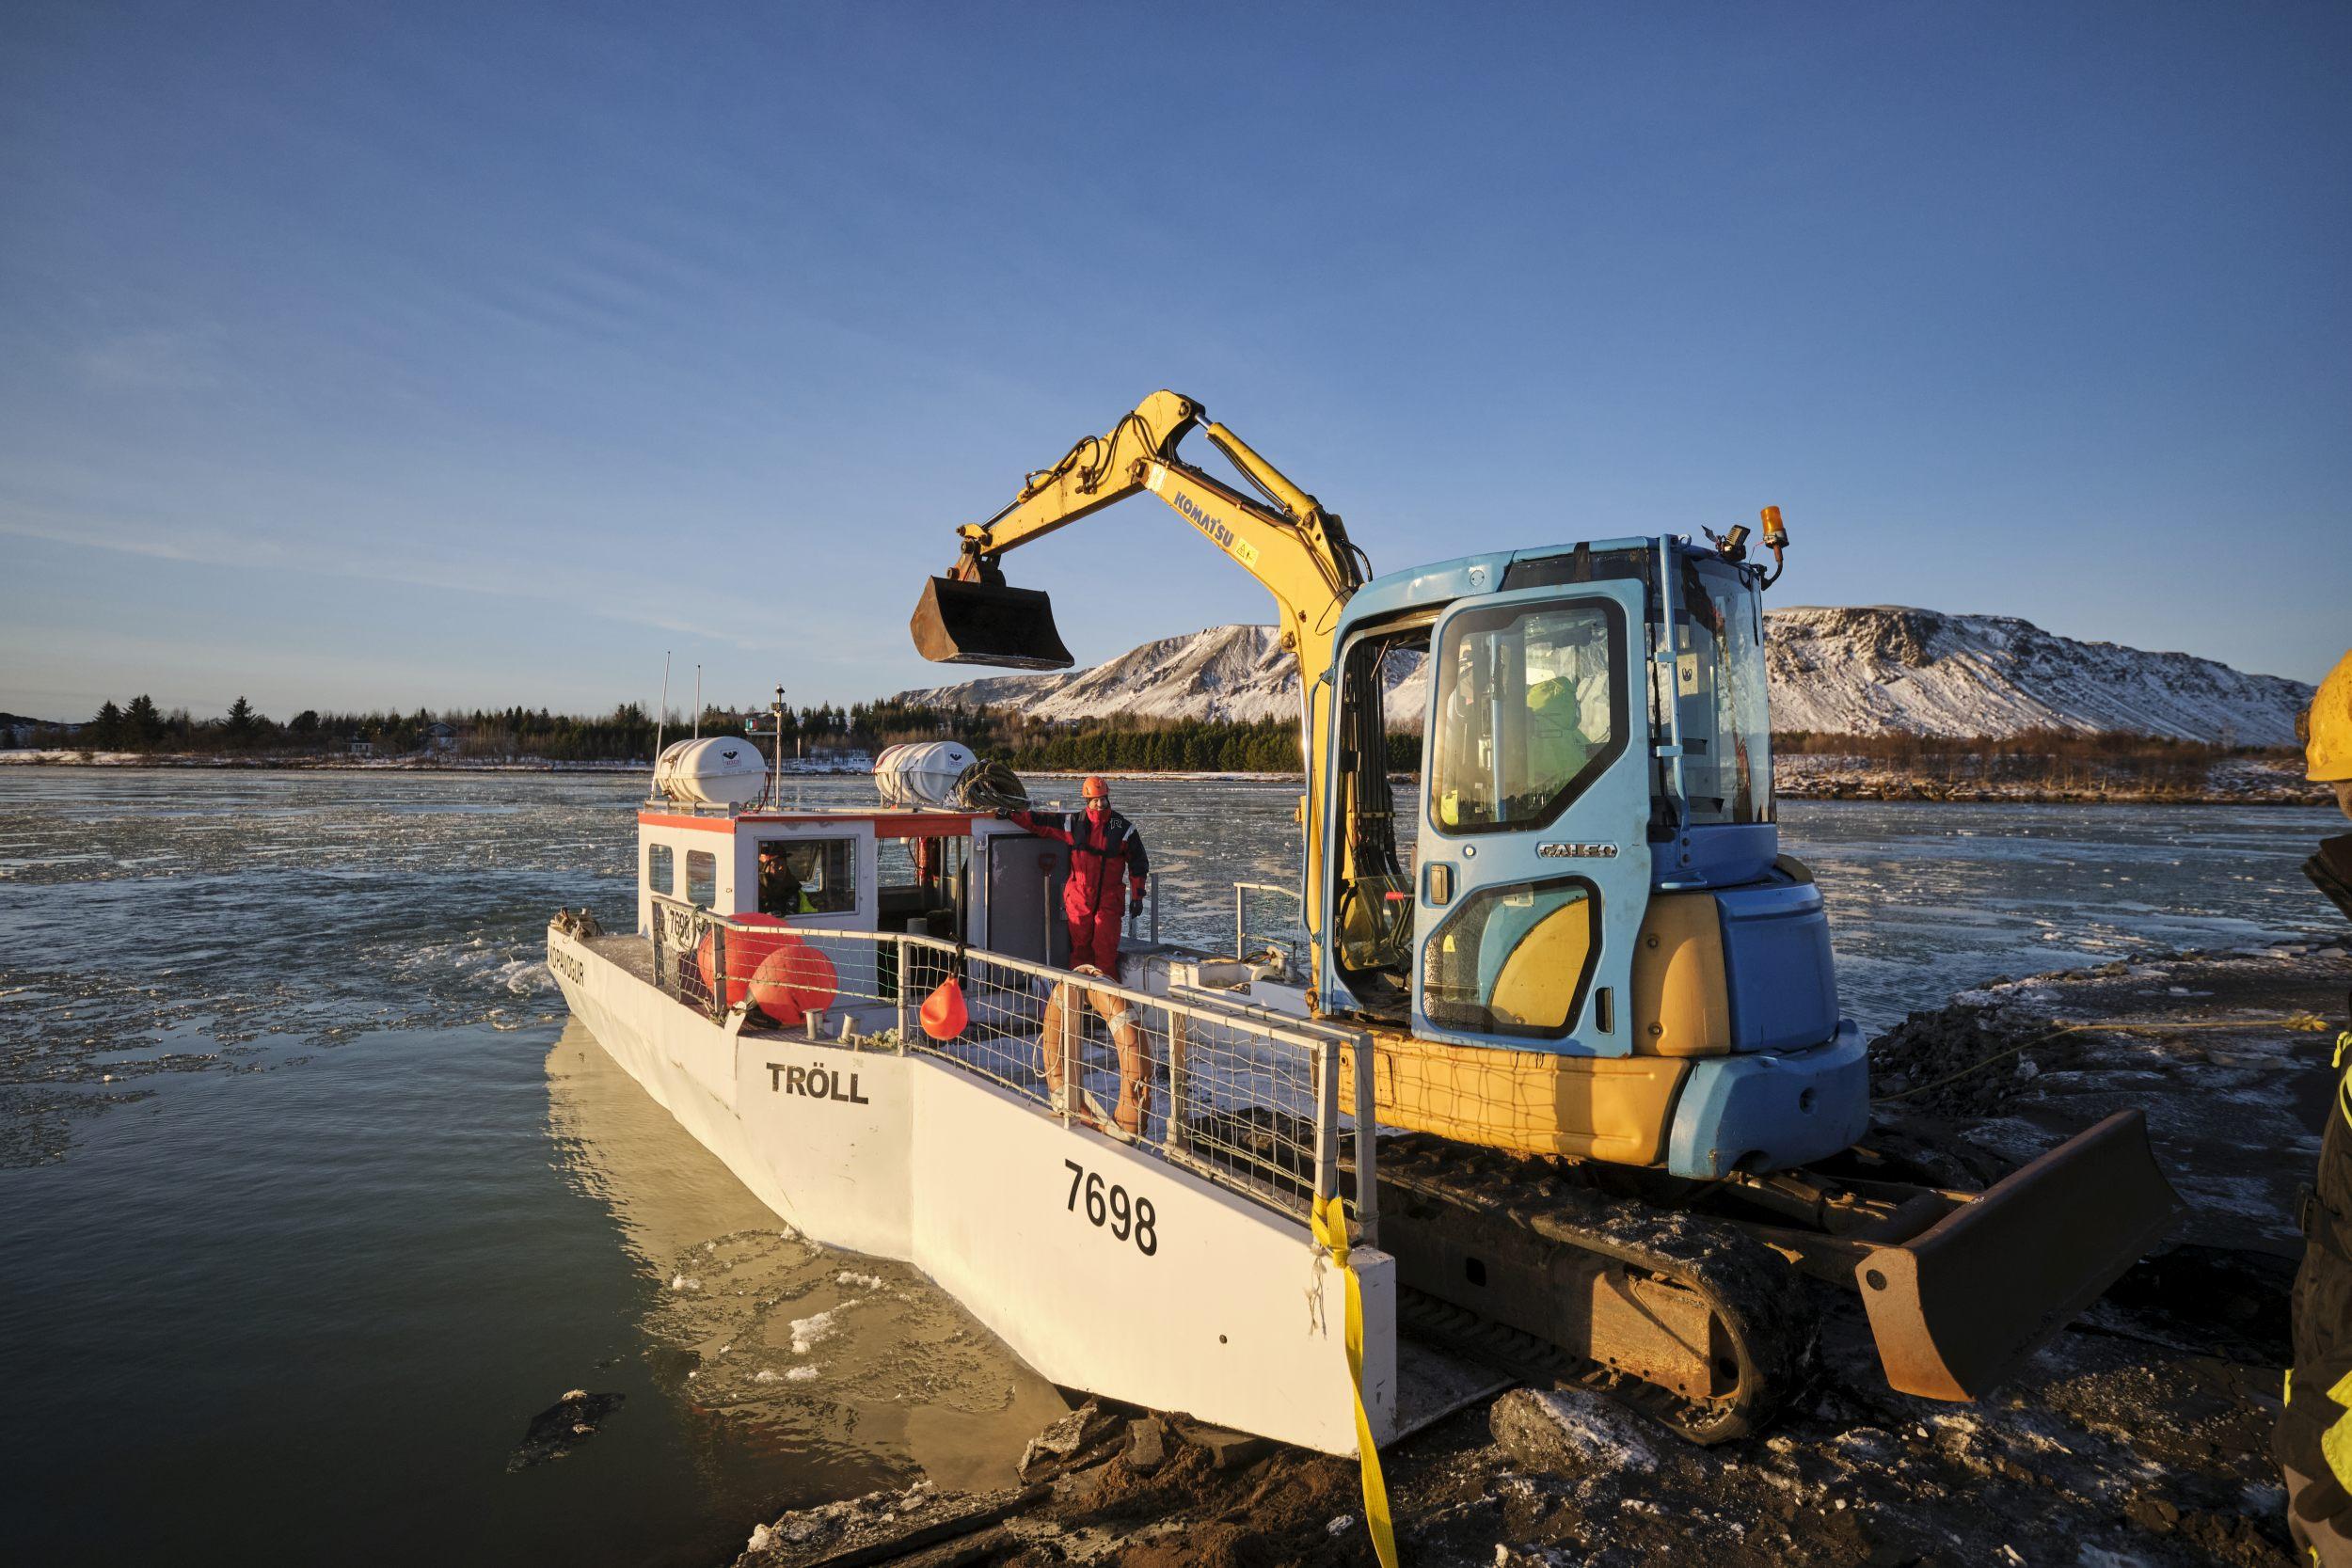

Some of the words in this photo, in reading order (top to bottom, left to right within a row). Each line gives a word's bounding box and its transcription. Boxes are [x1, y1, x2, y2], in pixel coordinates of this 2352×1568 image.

[1173, 490, 1234, 547] KOMATSU
[766, 1061, 869, 1105] TRÖLL
[1064, 1158, 1158, 1257] 7698
